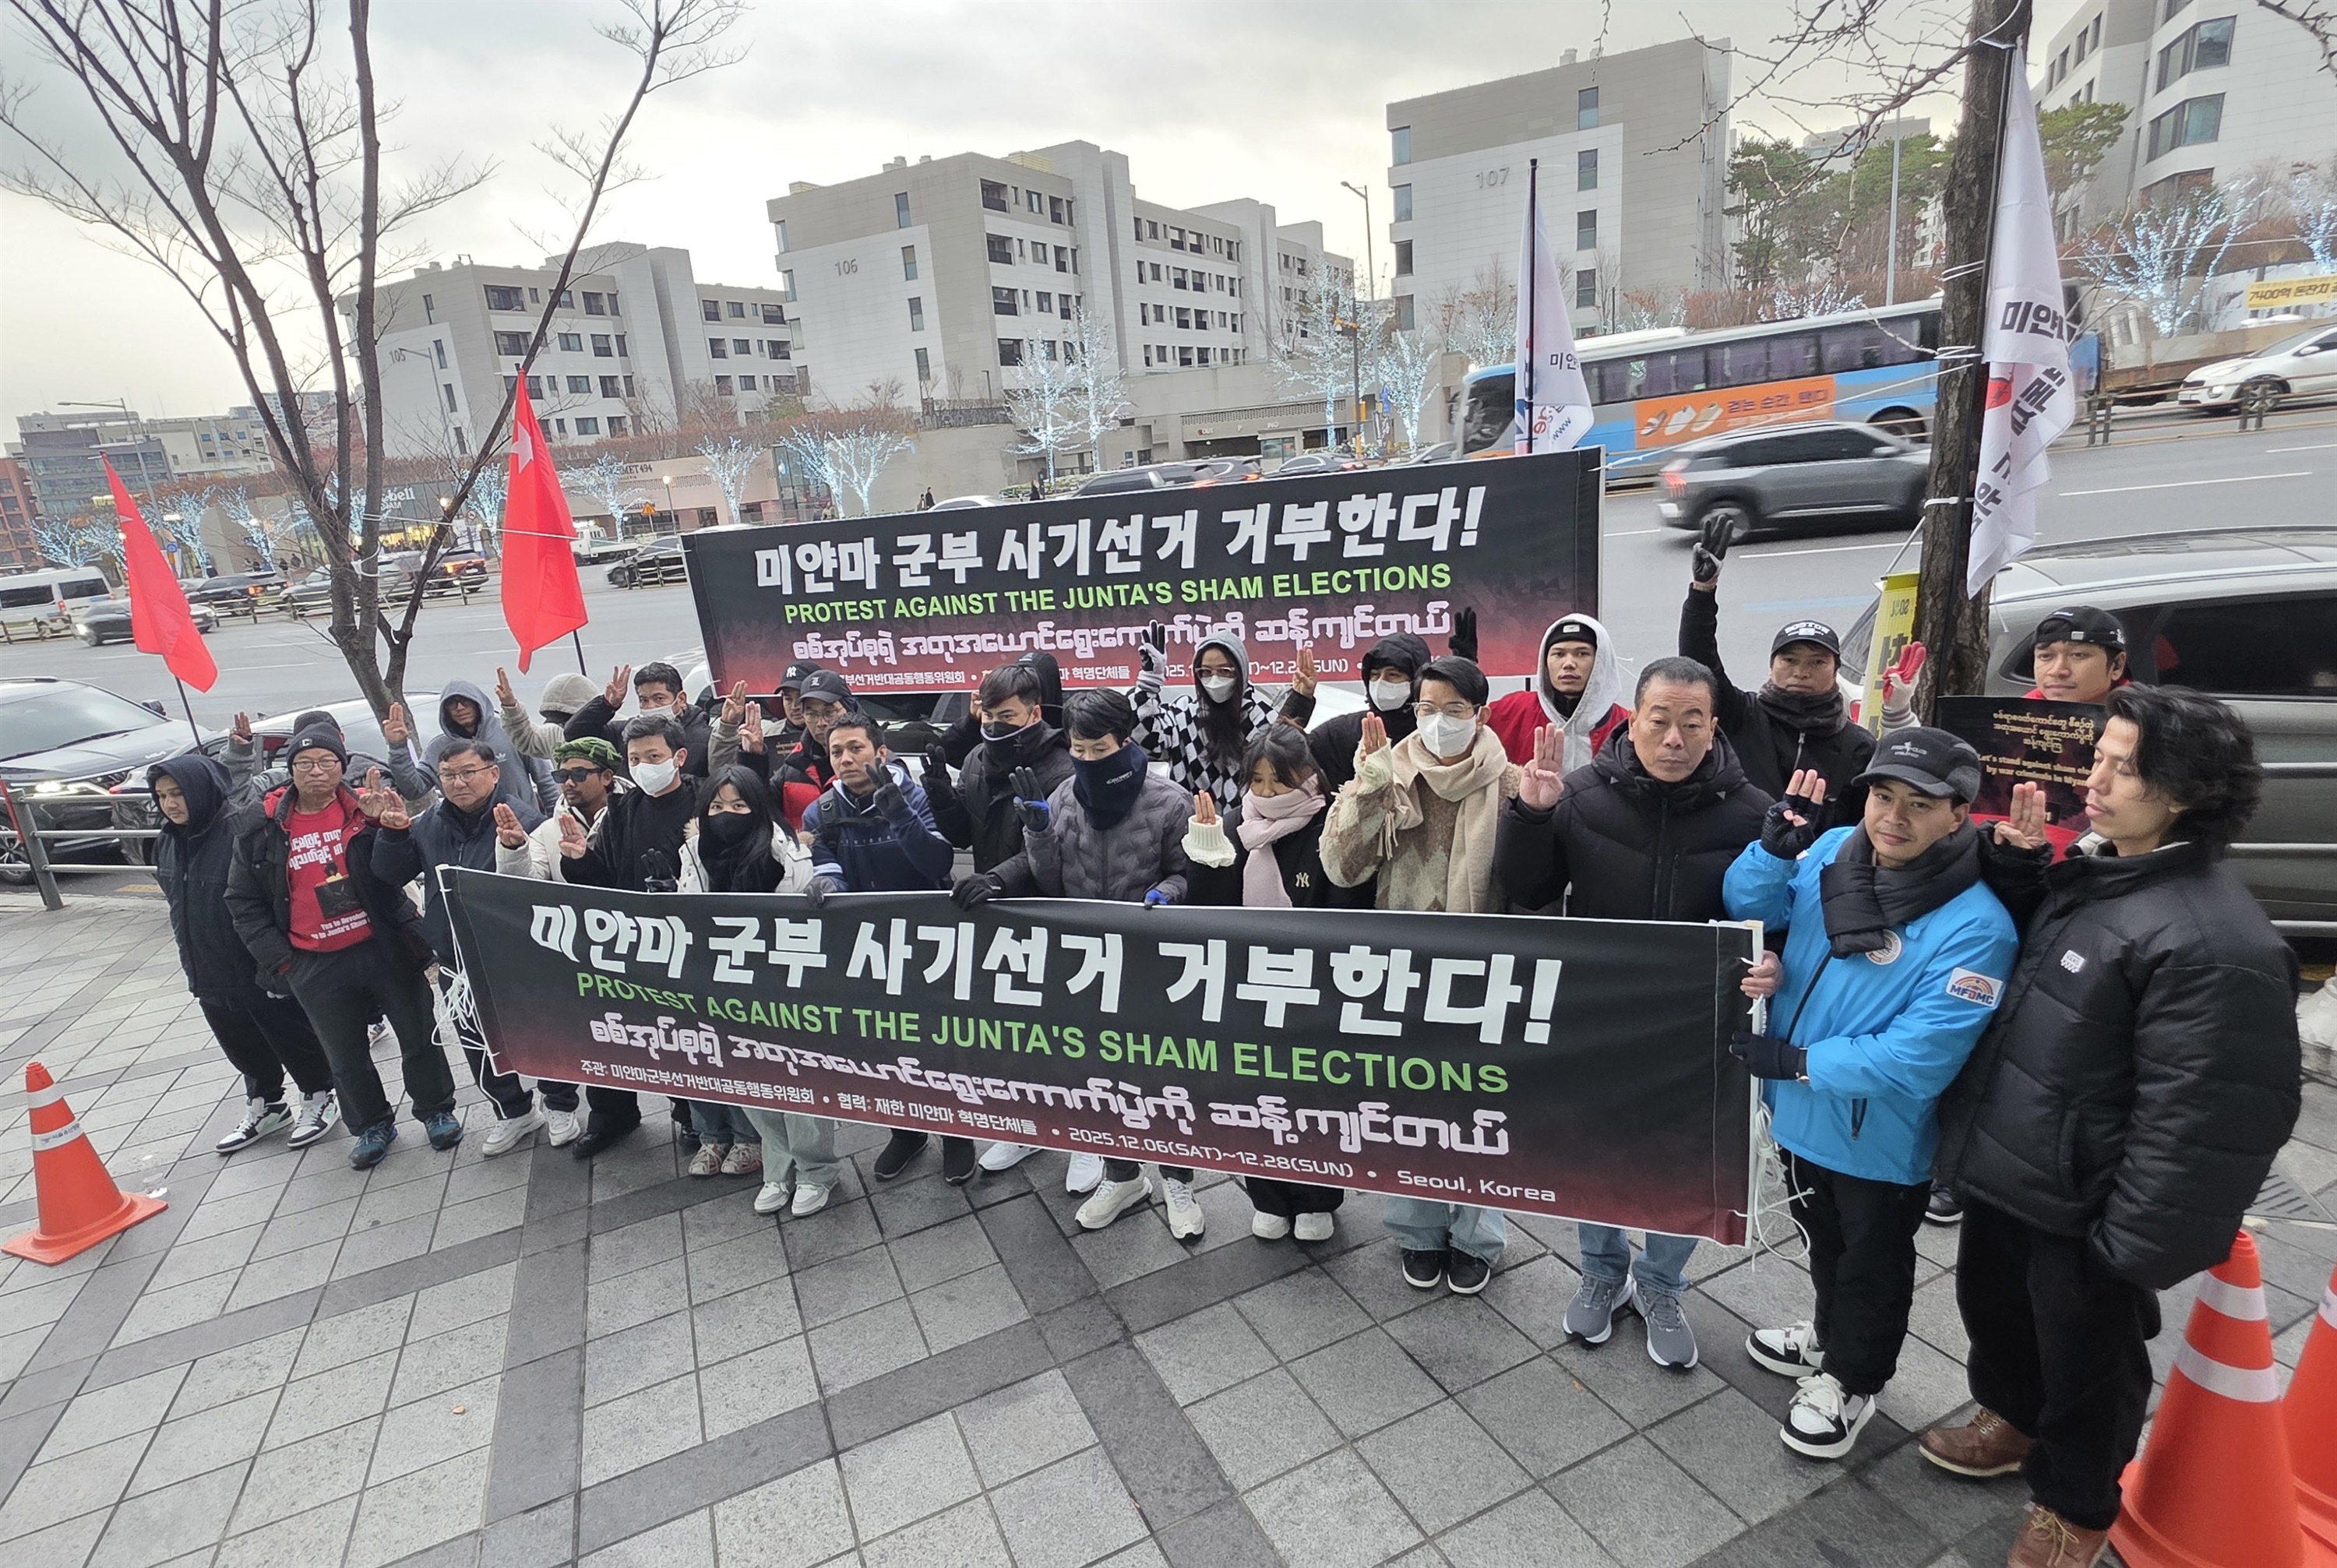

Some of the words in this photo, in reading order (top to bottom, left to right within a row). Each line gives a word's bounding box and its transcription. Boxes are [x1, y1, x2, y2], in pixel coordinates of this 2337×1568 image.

[1475, 167, 1510, 189] 107
[834, 258, 858, 277] 106
[2000, 301, 2065, 340] 미얀
[1549, 352, 1580, 370] 미얀
[755, 537, 881, 595] 미얀마
[893, 530, 983, 587] 군부
[997, 509, 1198, 579] 사기선거
[1221, 486, 1486, 564] 거부한다!
[784, 599, 887, 624] PROTEST
[894, 592, 998, 618] AGAINST
[1004, 589, 1056, 612] THE
[1063, 581, 1173, 609] JUNTA'S
[1181, 576, 1264, 603] SHAM
[1272, 563, 1451, 597] ELECTIONS
[1071, 665, 1130, 681] 혁명단체들
[2022, 759, 2052, 770] against
[530, 904, 693, 979] 미얀마
[707, 916, 827, 988] 군부
[846, 918, 1124, 1013] 사기선거
[1158, 939, 1563, 1045] 거부한다!
[576, 972, 698, 1013] PROTEST
[707, 996, 843, 1034] AGAINST
[852, 1009, 922, 1042] THE
[931, 1015, 1087, 1059] JUNTA'S
[1098, 1030, 1219, 1073] SHAM
[1233, 1041, 1509, 1094] ELECTIONS
[580, 1059, 609, 1076] 주관:
[610, 1063, 815, 1105] 미얀마군부선거반대공동행동위원회
[837, 1092, 872, 1112] 협력:
[875, 1097, 905, 1118] 재한
[908, 1102, 954, 1124] 미얀마
[957, 1109, 1038, 1136] 혁명단체들
[1396, 1170, 1472, 1194] Seoul,
[1479, 1179, 1556, 1203] Korea
